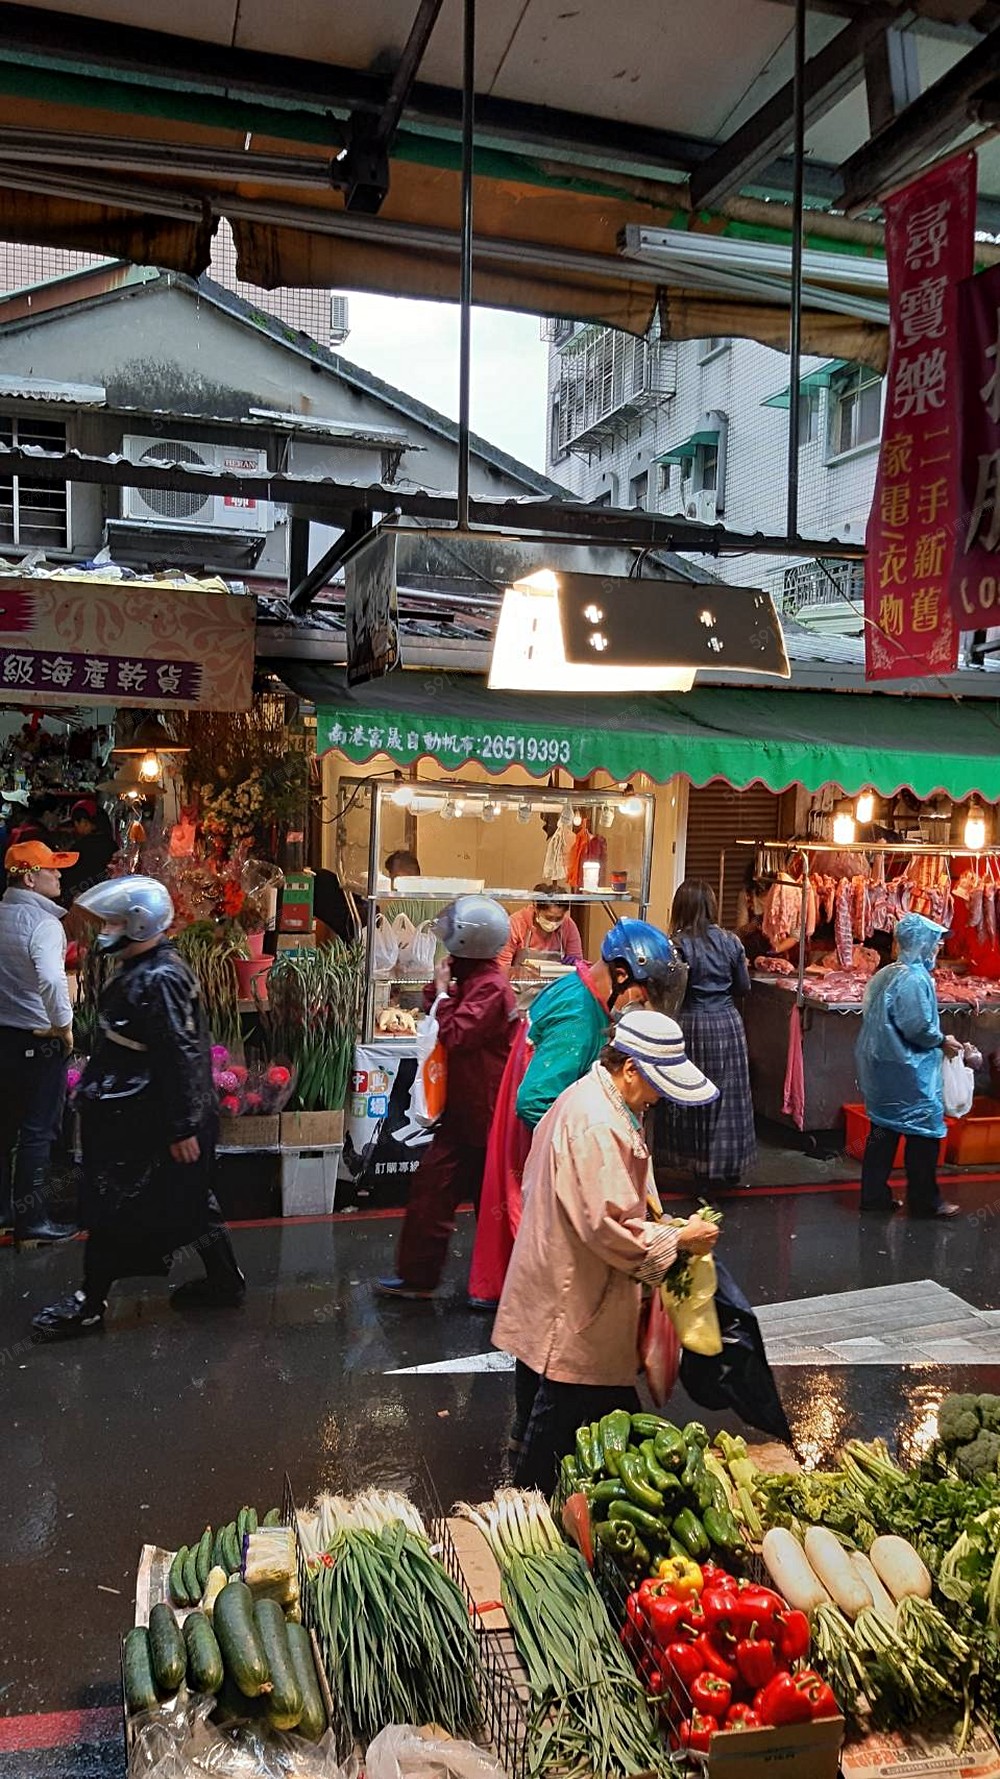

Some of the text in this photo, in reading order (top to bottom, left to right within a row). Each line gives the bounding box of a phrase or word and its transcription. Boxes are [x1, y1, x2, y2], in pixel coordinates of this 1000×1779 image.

[893, 199, 951, 419] 尋寶樂
[911, 426, 951, 633] 二手新舊
